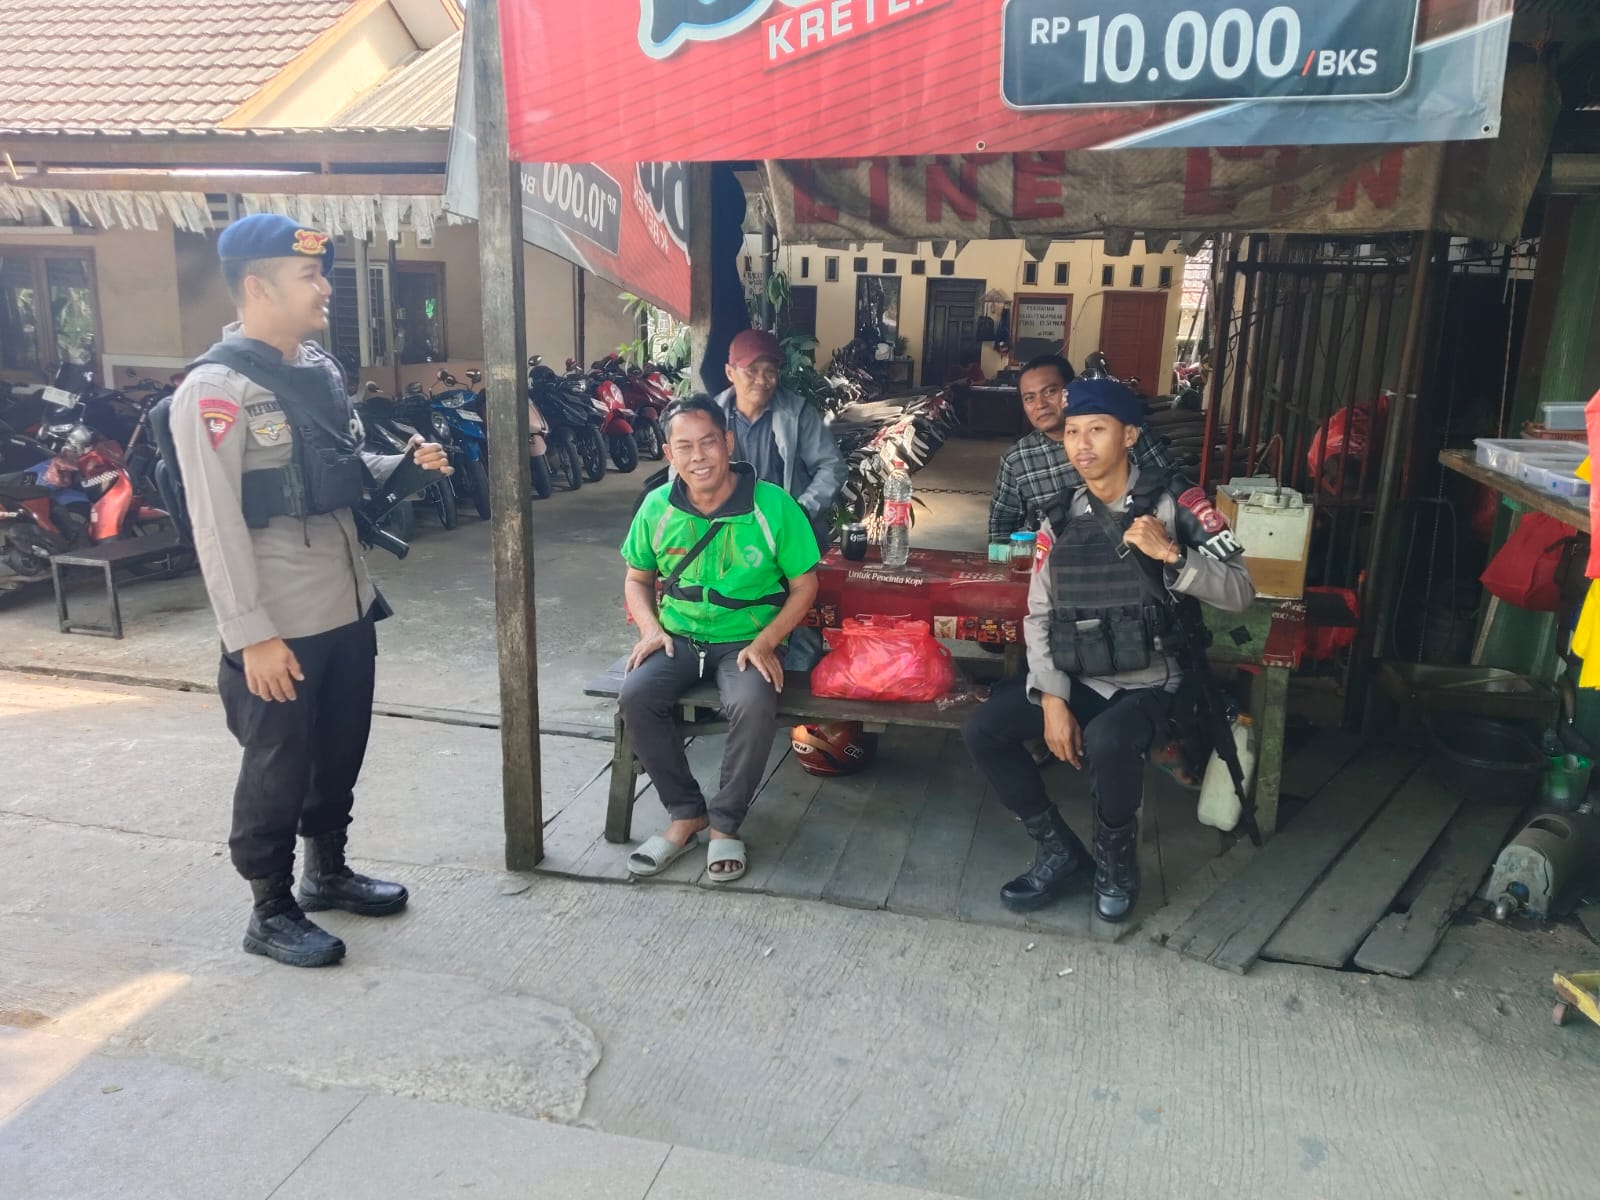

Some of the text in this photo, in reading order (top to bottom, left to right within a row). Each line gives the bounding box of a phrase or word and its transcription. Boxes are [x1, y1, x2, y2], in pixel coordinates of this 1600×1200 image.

[768, 0, 925, 60] KRE
[1030, 16, 1071, 45] RP
[1077, 6, 1301, 83] 10.000
[848, 570, 923, 588] Untuk Pencinta Kopi
